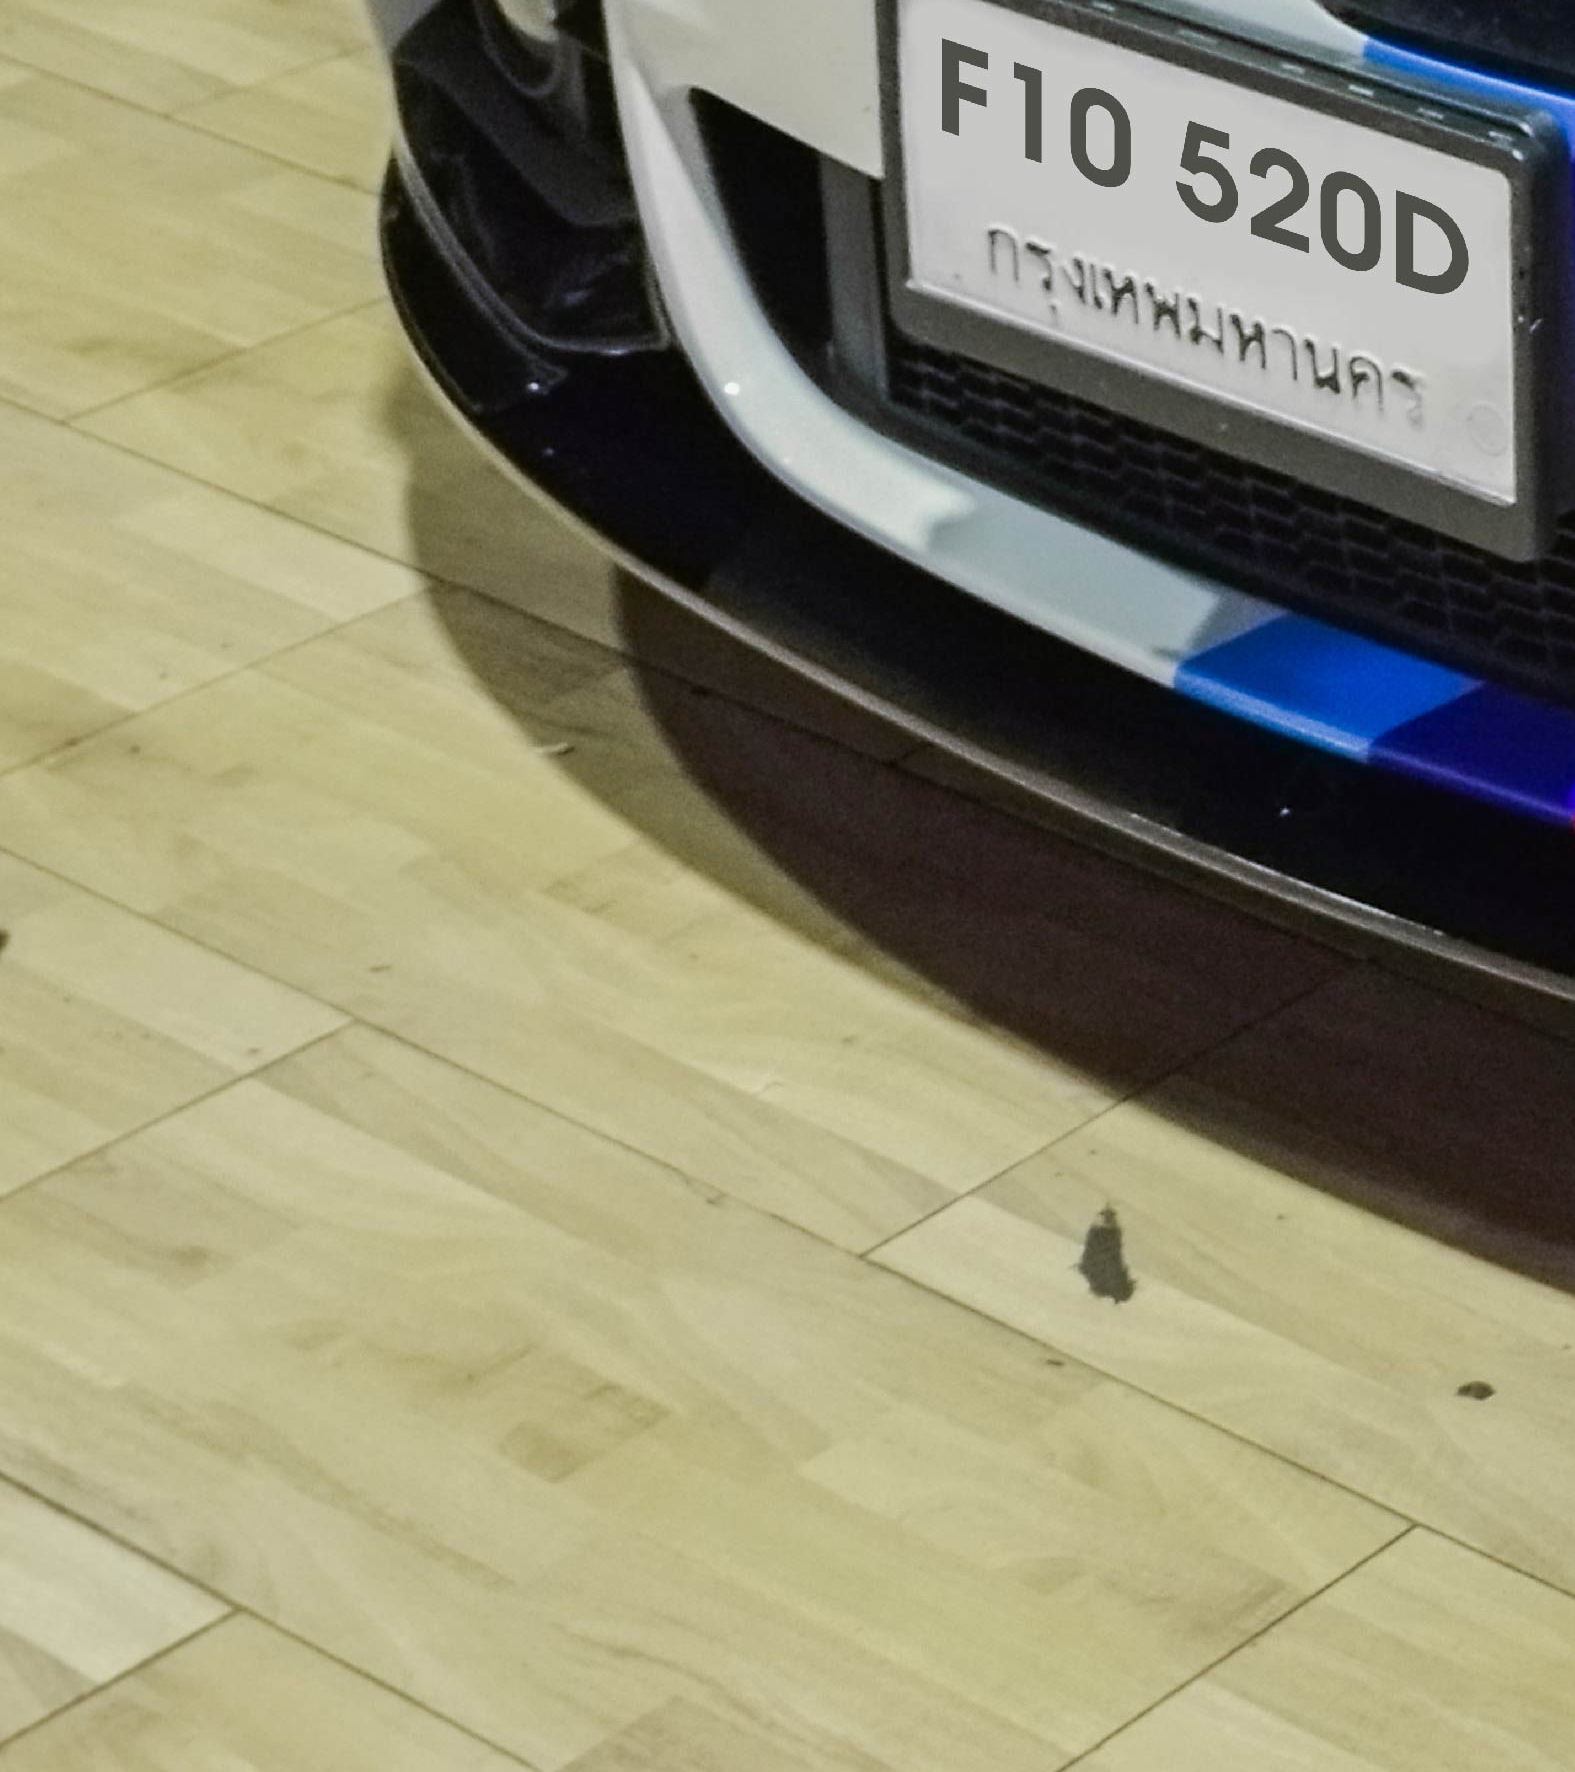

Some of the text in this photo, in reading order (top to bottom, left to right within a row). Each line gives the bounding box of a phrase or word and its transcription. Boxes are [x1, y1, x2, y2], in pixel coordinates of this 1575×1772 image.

[941, 37, 1471, 296] F10 520D
[987, 227, 1427, 426] กรุงเทพมหานคร
